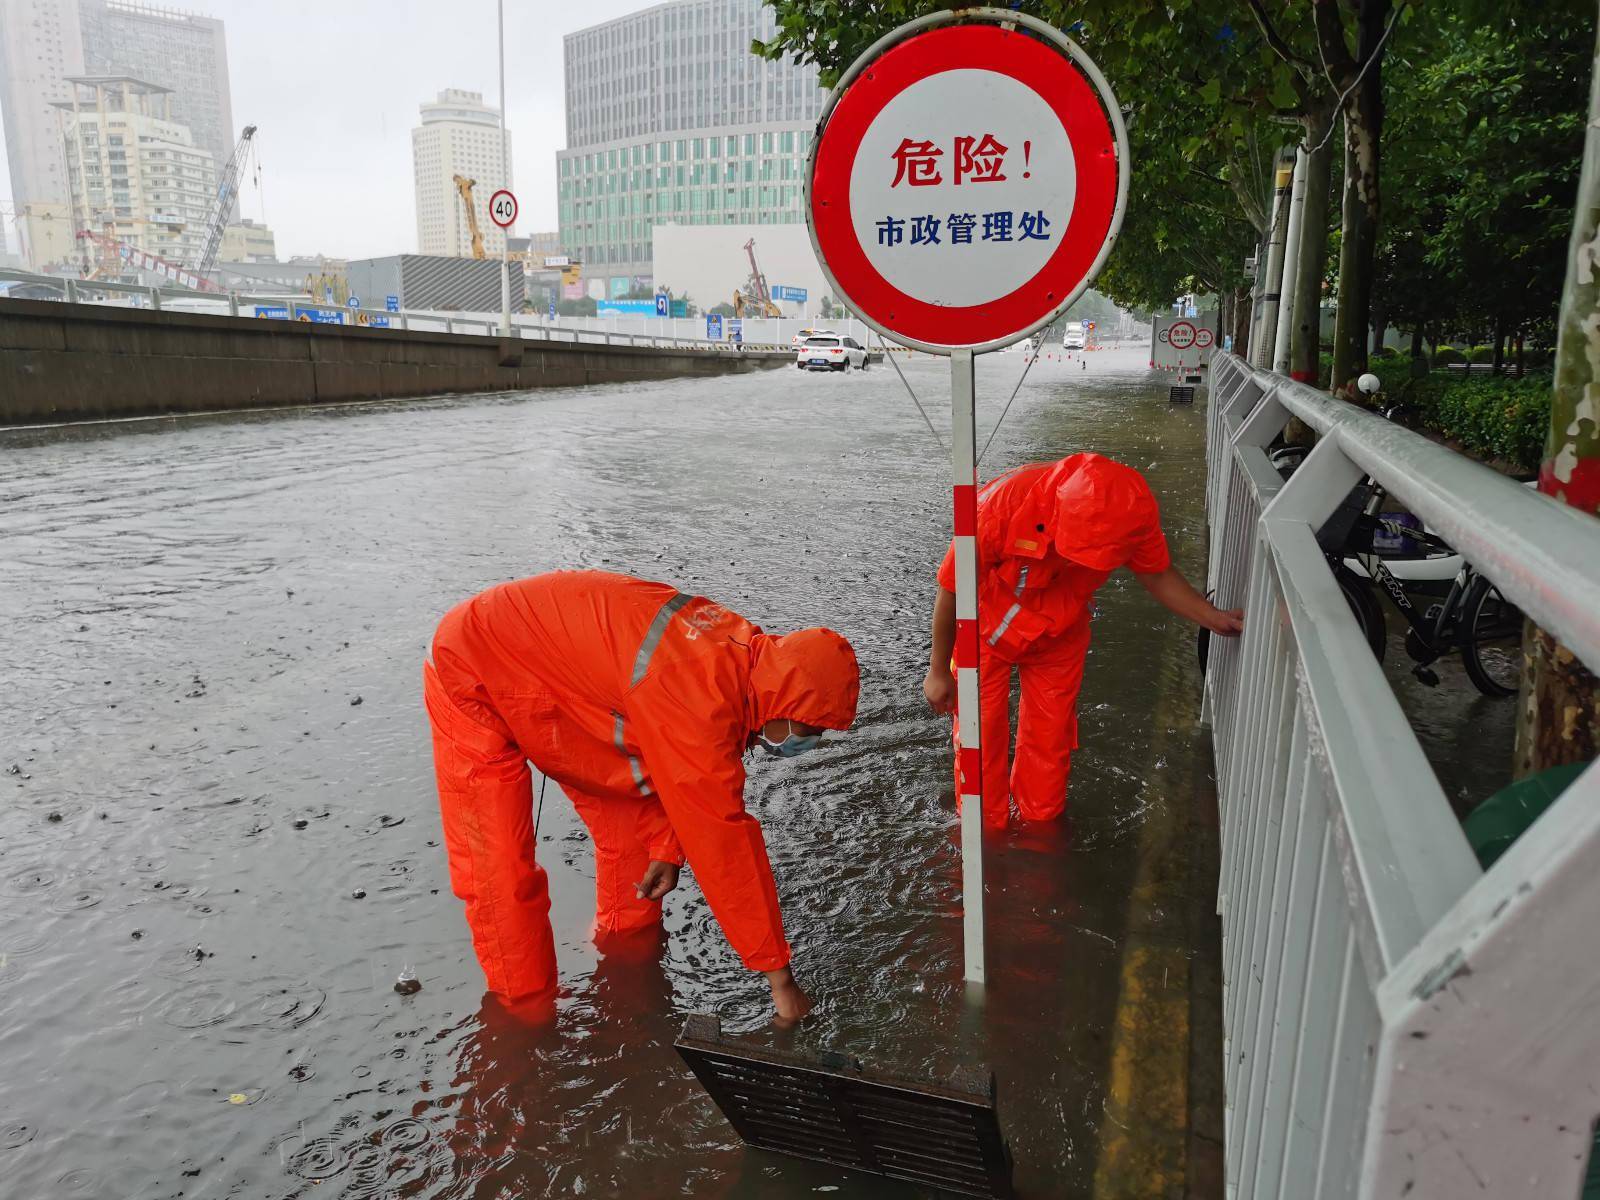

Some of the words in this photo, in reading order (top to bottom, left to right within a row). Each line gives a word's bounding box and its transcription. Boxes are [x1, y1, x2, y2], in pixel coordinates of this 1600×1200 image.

[890, 133, 1032, 189] 危险！
[495, 200, 513, 218] 40
[874, 210, 1051, 247] 市政管理处
